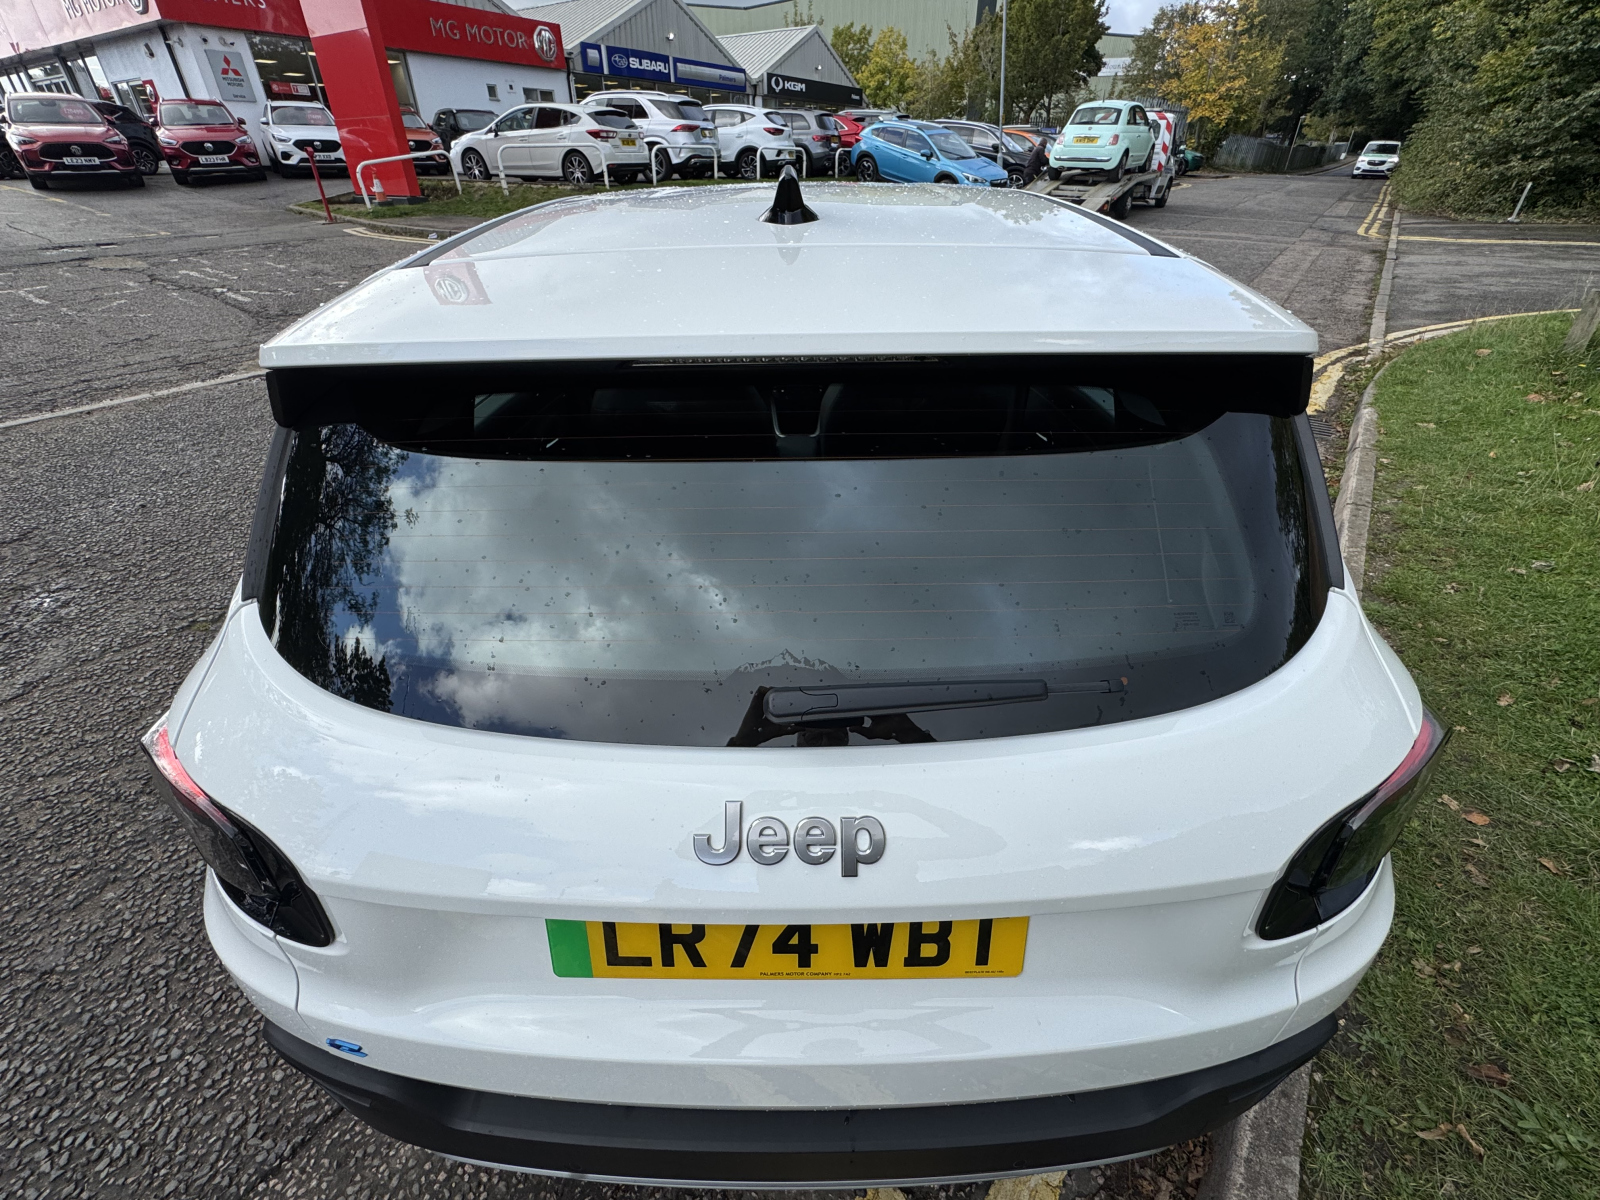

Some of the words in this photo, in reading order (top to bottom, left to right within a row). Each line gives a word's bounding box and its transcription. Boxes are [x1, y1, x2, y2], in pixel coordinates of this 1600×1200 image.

[429, 17, 460, 40] MG
[465, 23, 529, 50] MOTOR
[535, 28, 557, 60] MG
[629, 57, 669, 74] SUBARU
[784, 80, 806, 92] KGM
[693, 800, 886, 878] Jeep
[602, 921, 818, 968] LR74
